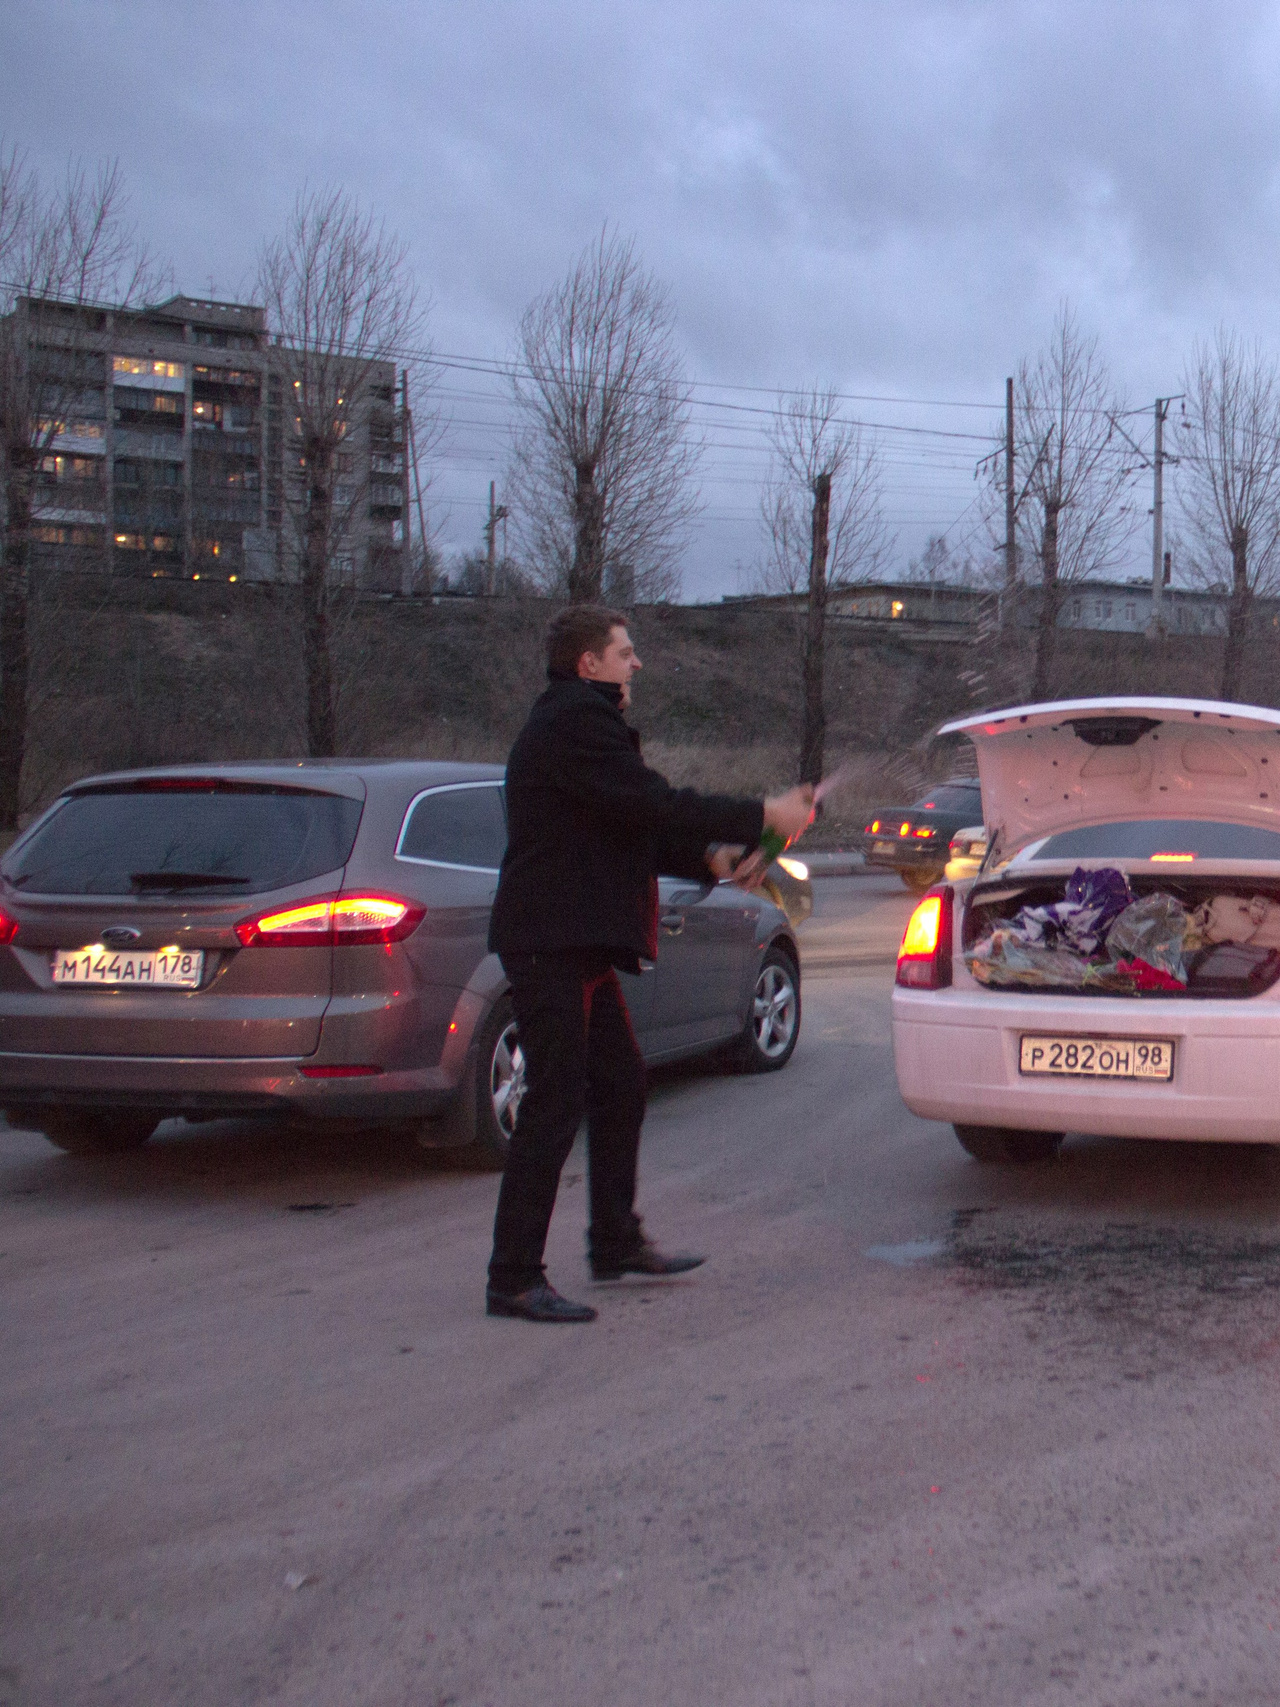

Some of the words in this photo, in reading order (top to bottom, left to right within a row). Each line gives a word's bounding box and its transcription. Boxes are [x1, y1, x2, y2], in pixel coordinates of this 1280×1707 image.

[158, 955, 192, 974] 178
[163, 974, 181, 982] RUS
[1137, 1045, 1162, 1066] 98
[1135, 1066, 1154, 1075] RUS
